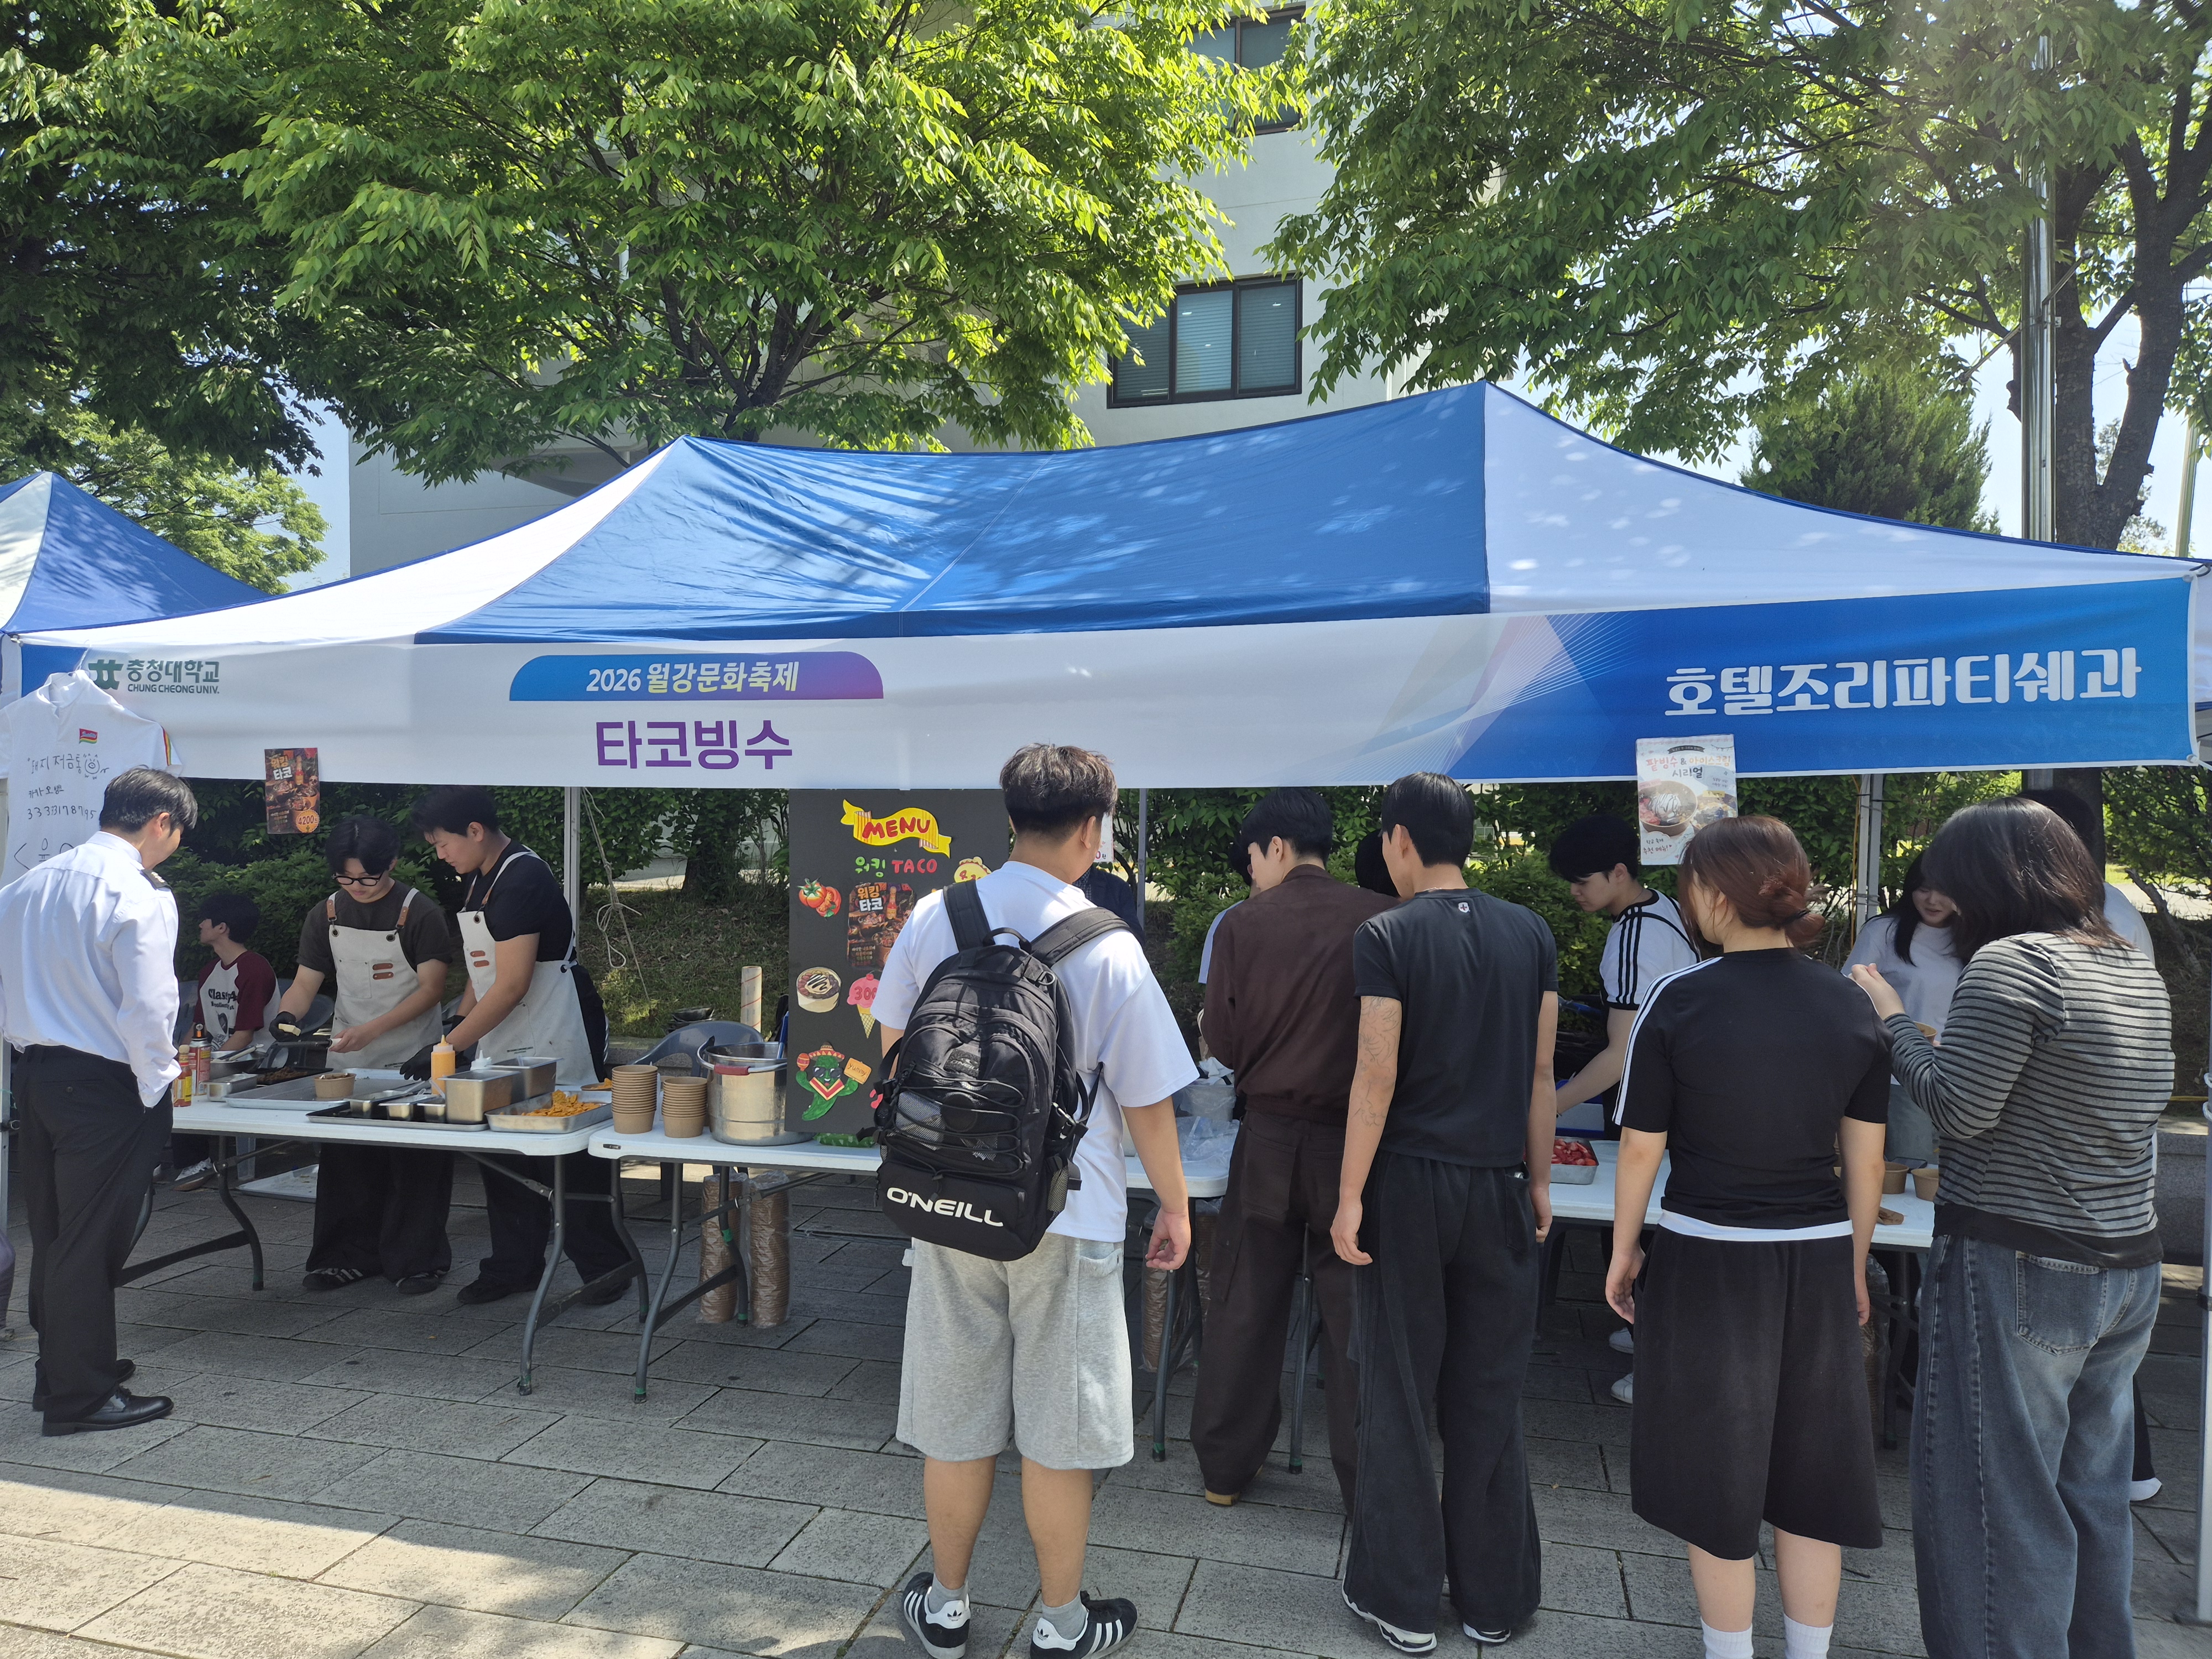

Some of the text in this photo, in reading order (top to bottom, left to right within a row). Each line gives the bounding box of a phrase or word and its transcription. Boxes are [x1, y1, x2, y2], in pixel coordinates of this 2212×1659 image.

[127, 659, 220, 684] 충청대학교
[586, 661, 799, 693] 2026 월강문화축제
[127, 684, 220, 694] CHUNG CHEONG UNIV.
[1665, 647, 2142, 716] 호텔조리파티쉐과
[596, 719, 793, 770] 타코빙수
[273, 766, 293, 780] 타코
[1646, 756, 1678, 772] 팥빙수
[1689, 756, 1731, 767] 아이스크림
[1672, 766, 1703, 779] 시리얼
[862, 816, 931, 839] MENU
[855, 856, 938, 878] 워킹 TACO
[857, 885, 880, 900] 워킹
[859, 898, 884, 912] 타코
[847, 1063, 867, 1077] yummy
[886, 1187, 1004, 1227] O'NEILL
